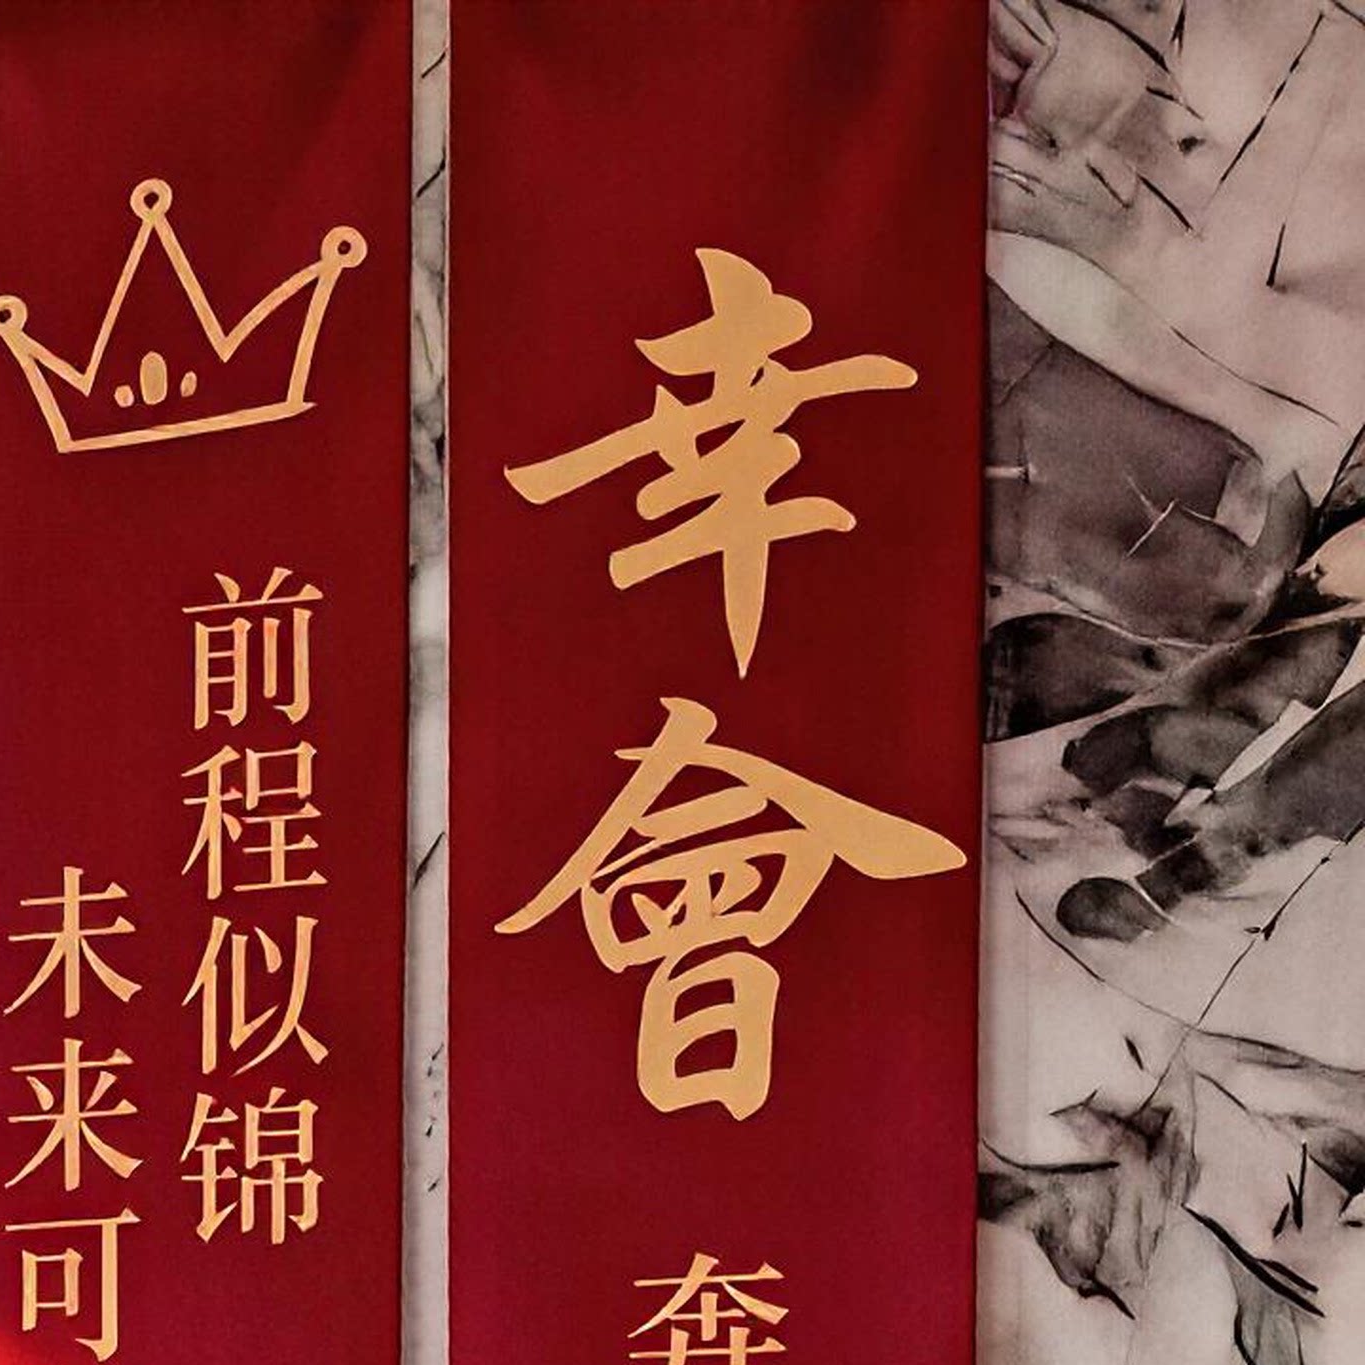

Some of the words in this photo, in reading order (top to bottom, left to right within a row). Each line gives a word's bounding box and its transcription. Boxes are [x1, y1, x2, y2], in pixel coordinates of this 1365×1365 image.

[180, 566, 330, 1245] 前程似锦
[494, 247, 968, 1122] 幸會
